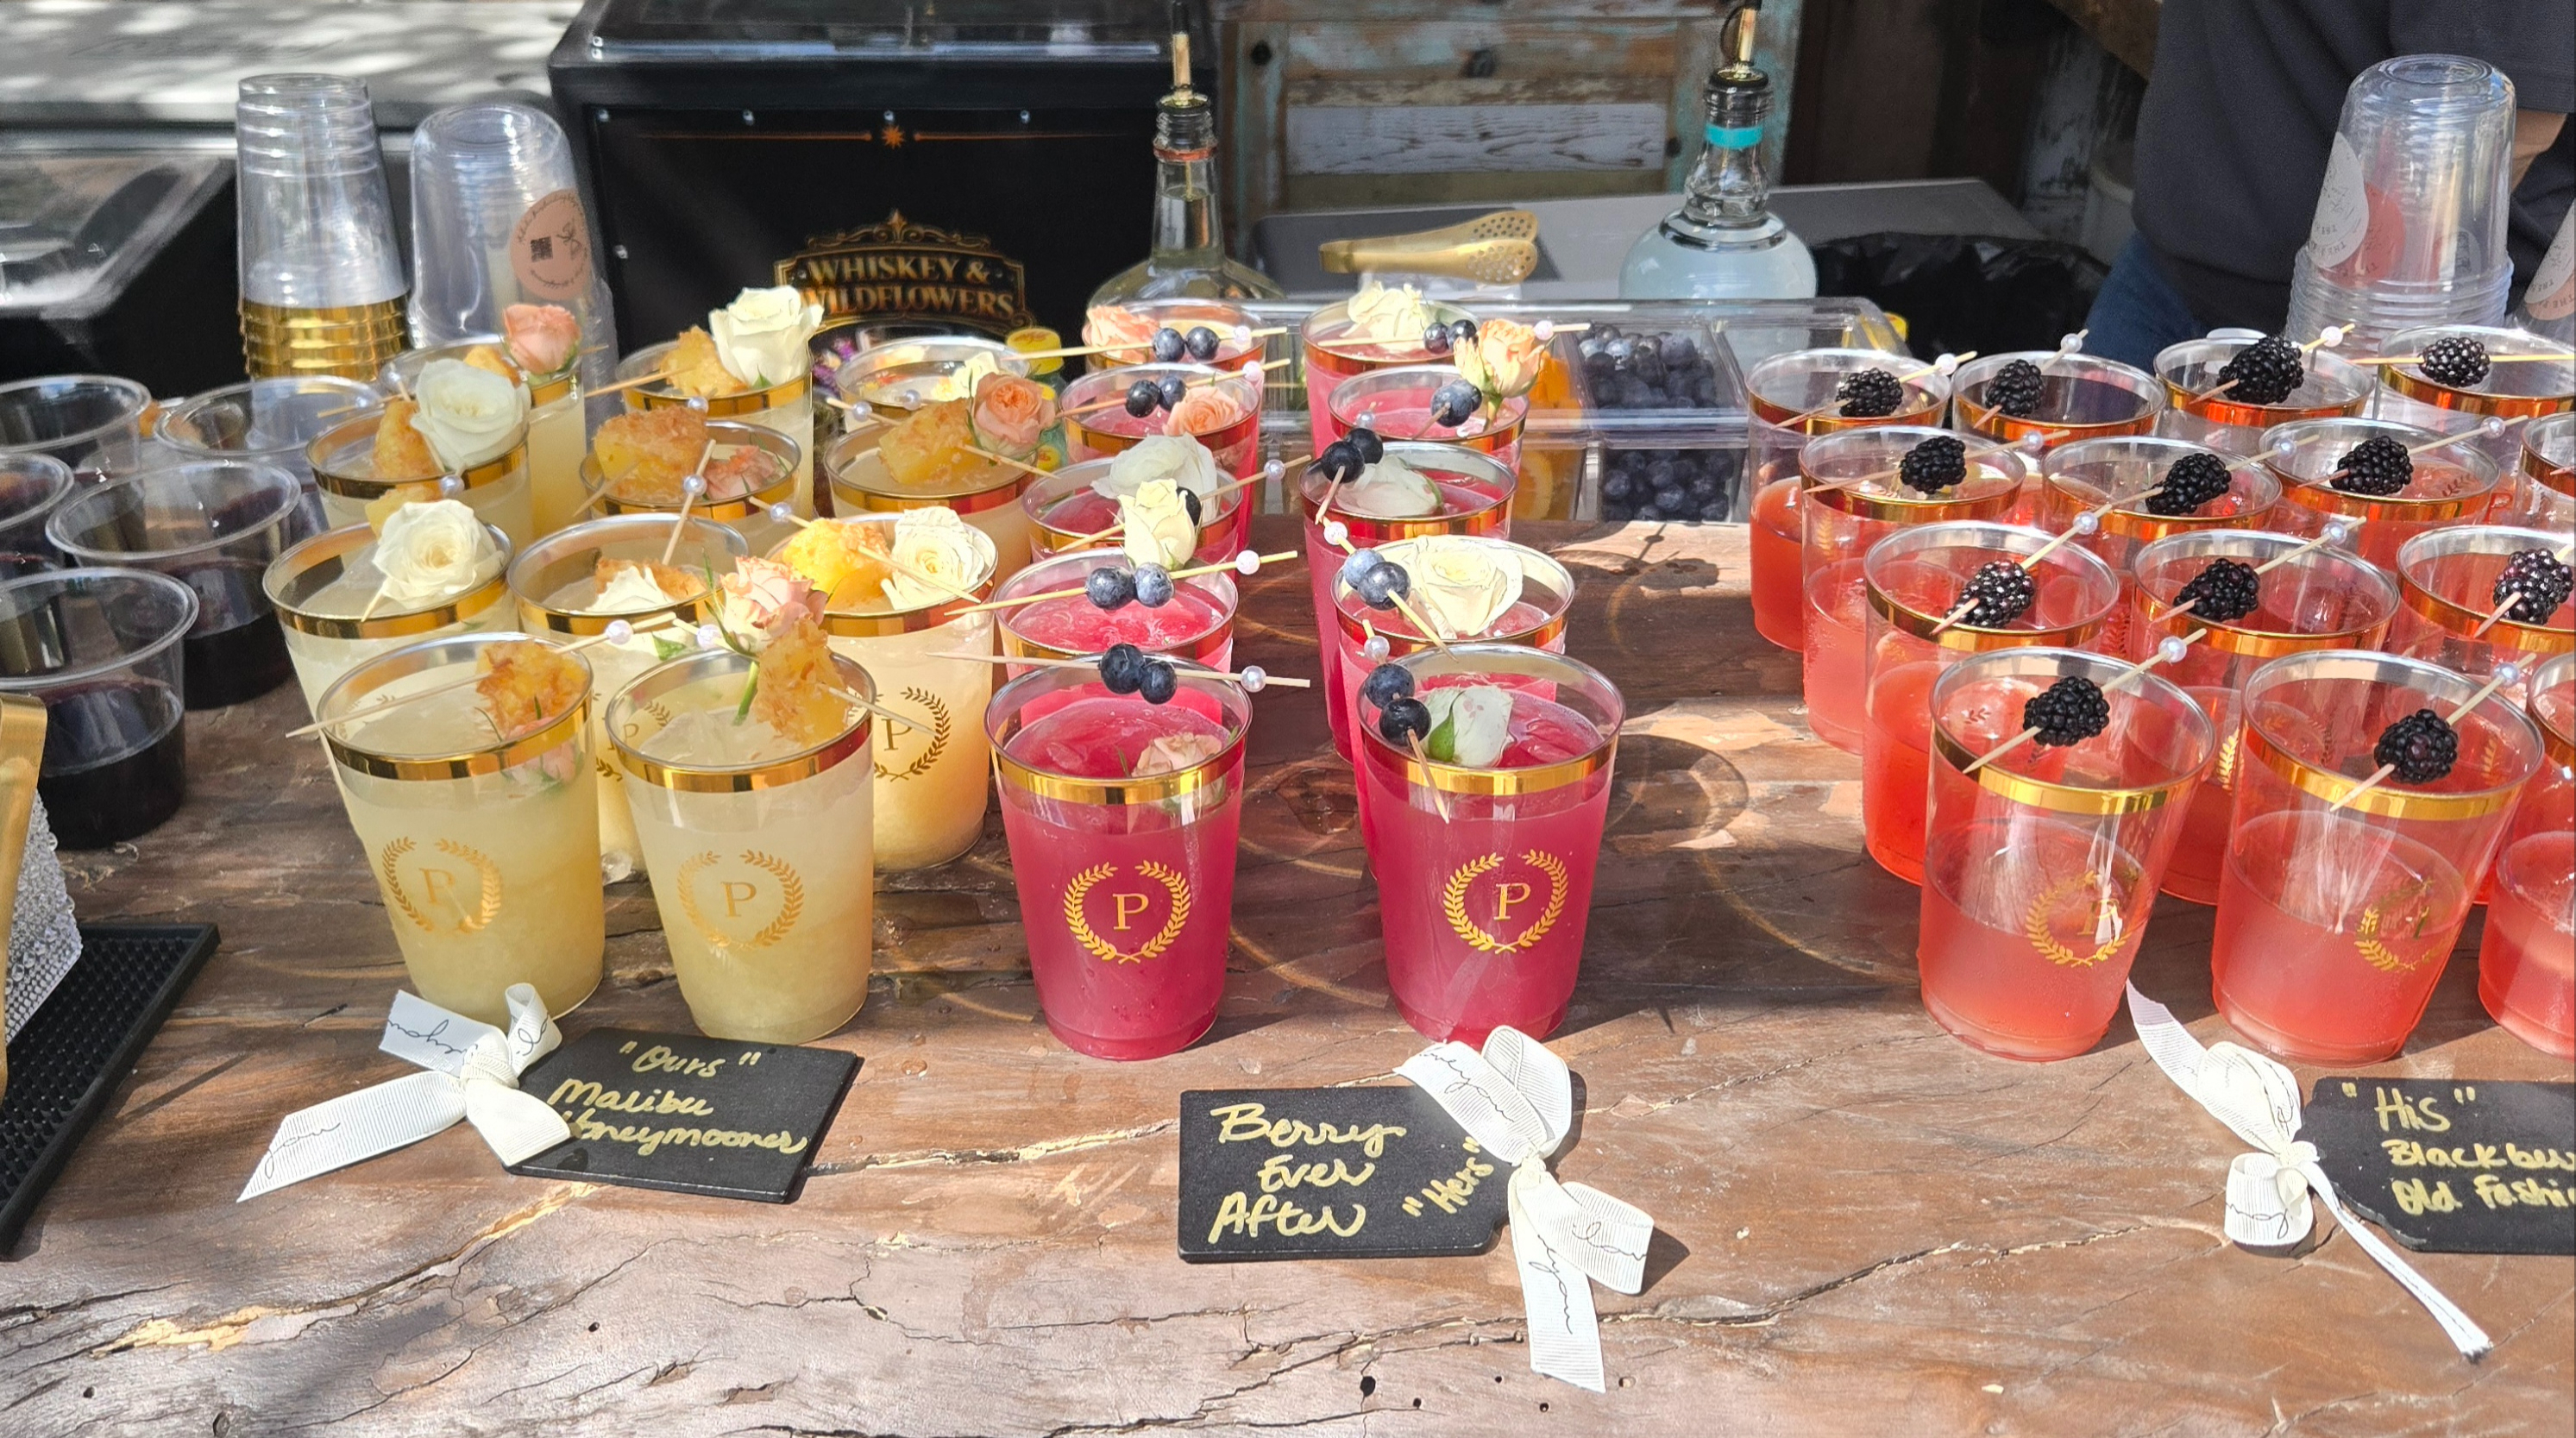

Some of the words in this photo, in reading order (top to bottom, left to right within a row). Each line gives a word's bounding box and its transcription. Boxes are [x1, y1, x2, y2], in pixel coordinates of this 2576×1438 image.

[807, 255, 960, 284] WHISKEY
[965, 260, 991, 285] &
[883, 717, 913, 751] P
[418, 867, 456, 905] P
[721, 881, 757, 918] P
[1494, 882, 1531, 920] P
[1113, 892, 1149, 931] P
[547, 1078, 714, 1116] Malibu
[1209, 1102, 1407, 1158] Berry
[1258, 1154, 1376, 1193] Ever
[2391, 1177, 2463, 1216] Old
[1208, 1192, 1367, 1244] After
